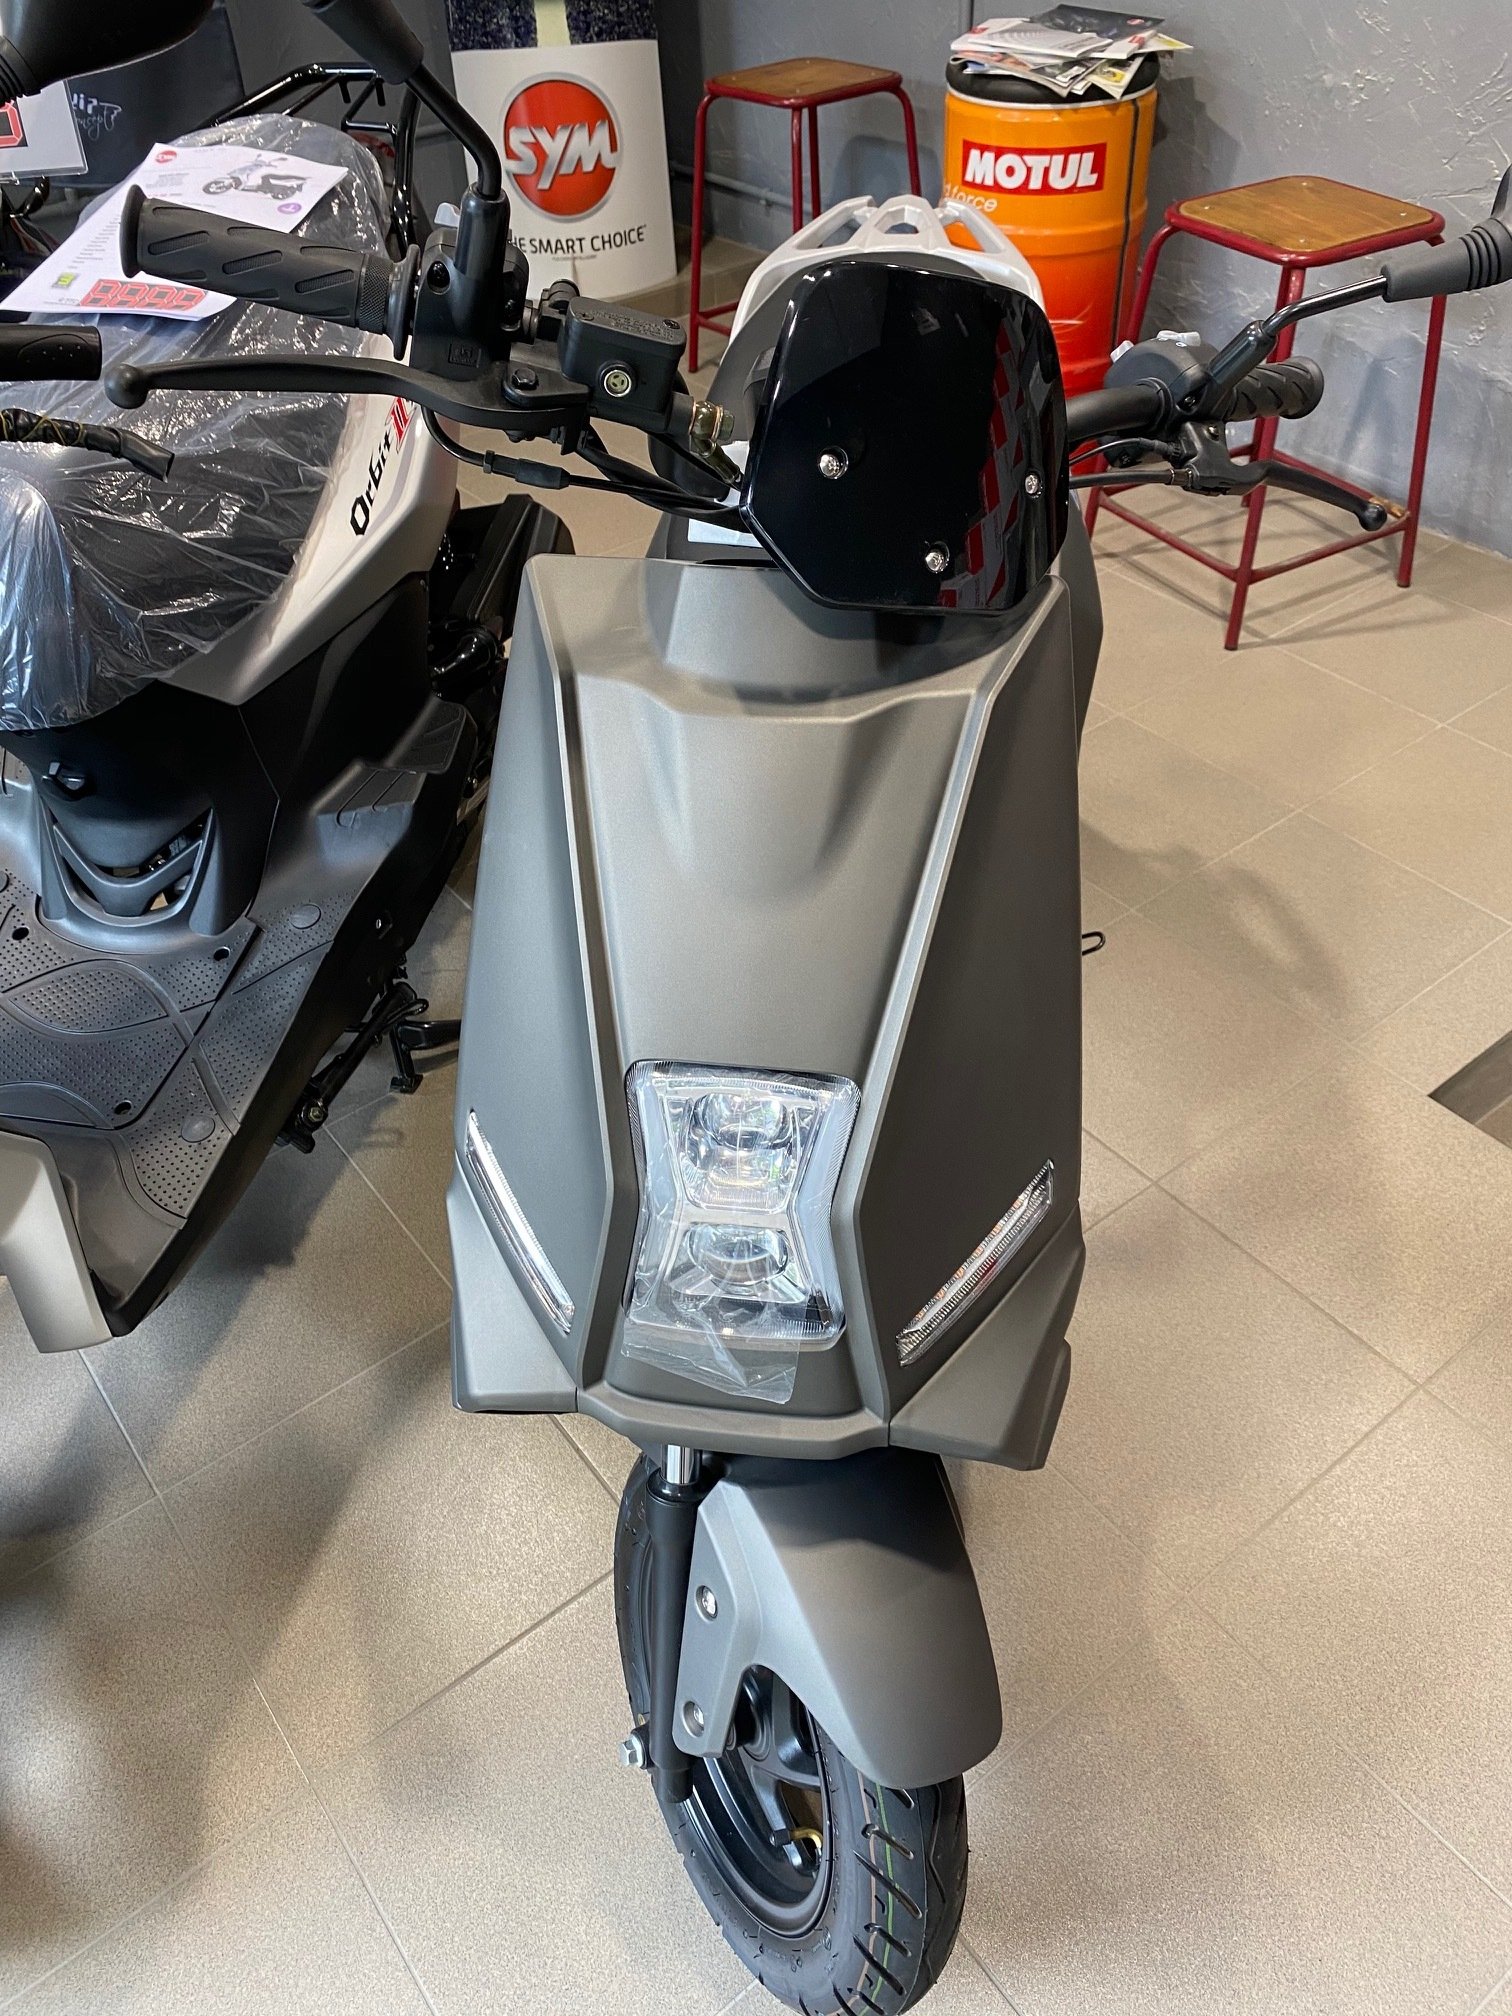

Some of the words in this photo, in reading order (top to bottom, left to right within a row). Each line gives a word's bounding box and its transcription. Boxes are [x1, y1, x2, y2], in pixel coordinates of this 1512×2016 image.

[504, 120, 620, 189] SYM
[964, 148, 1098, 189] MOTUL
[530, 237, 585, 254] SMART
[350, 426, 392, 535] Orbit
